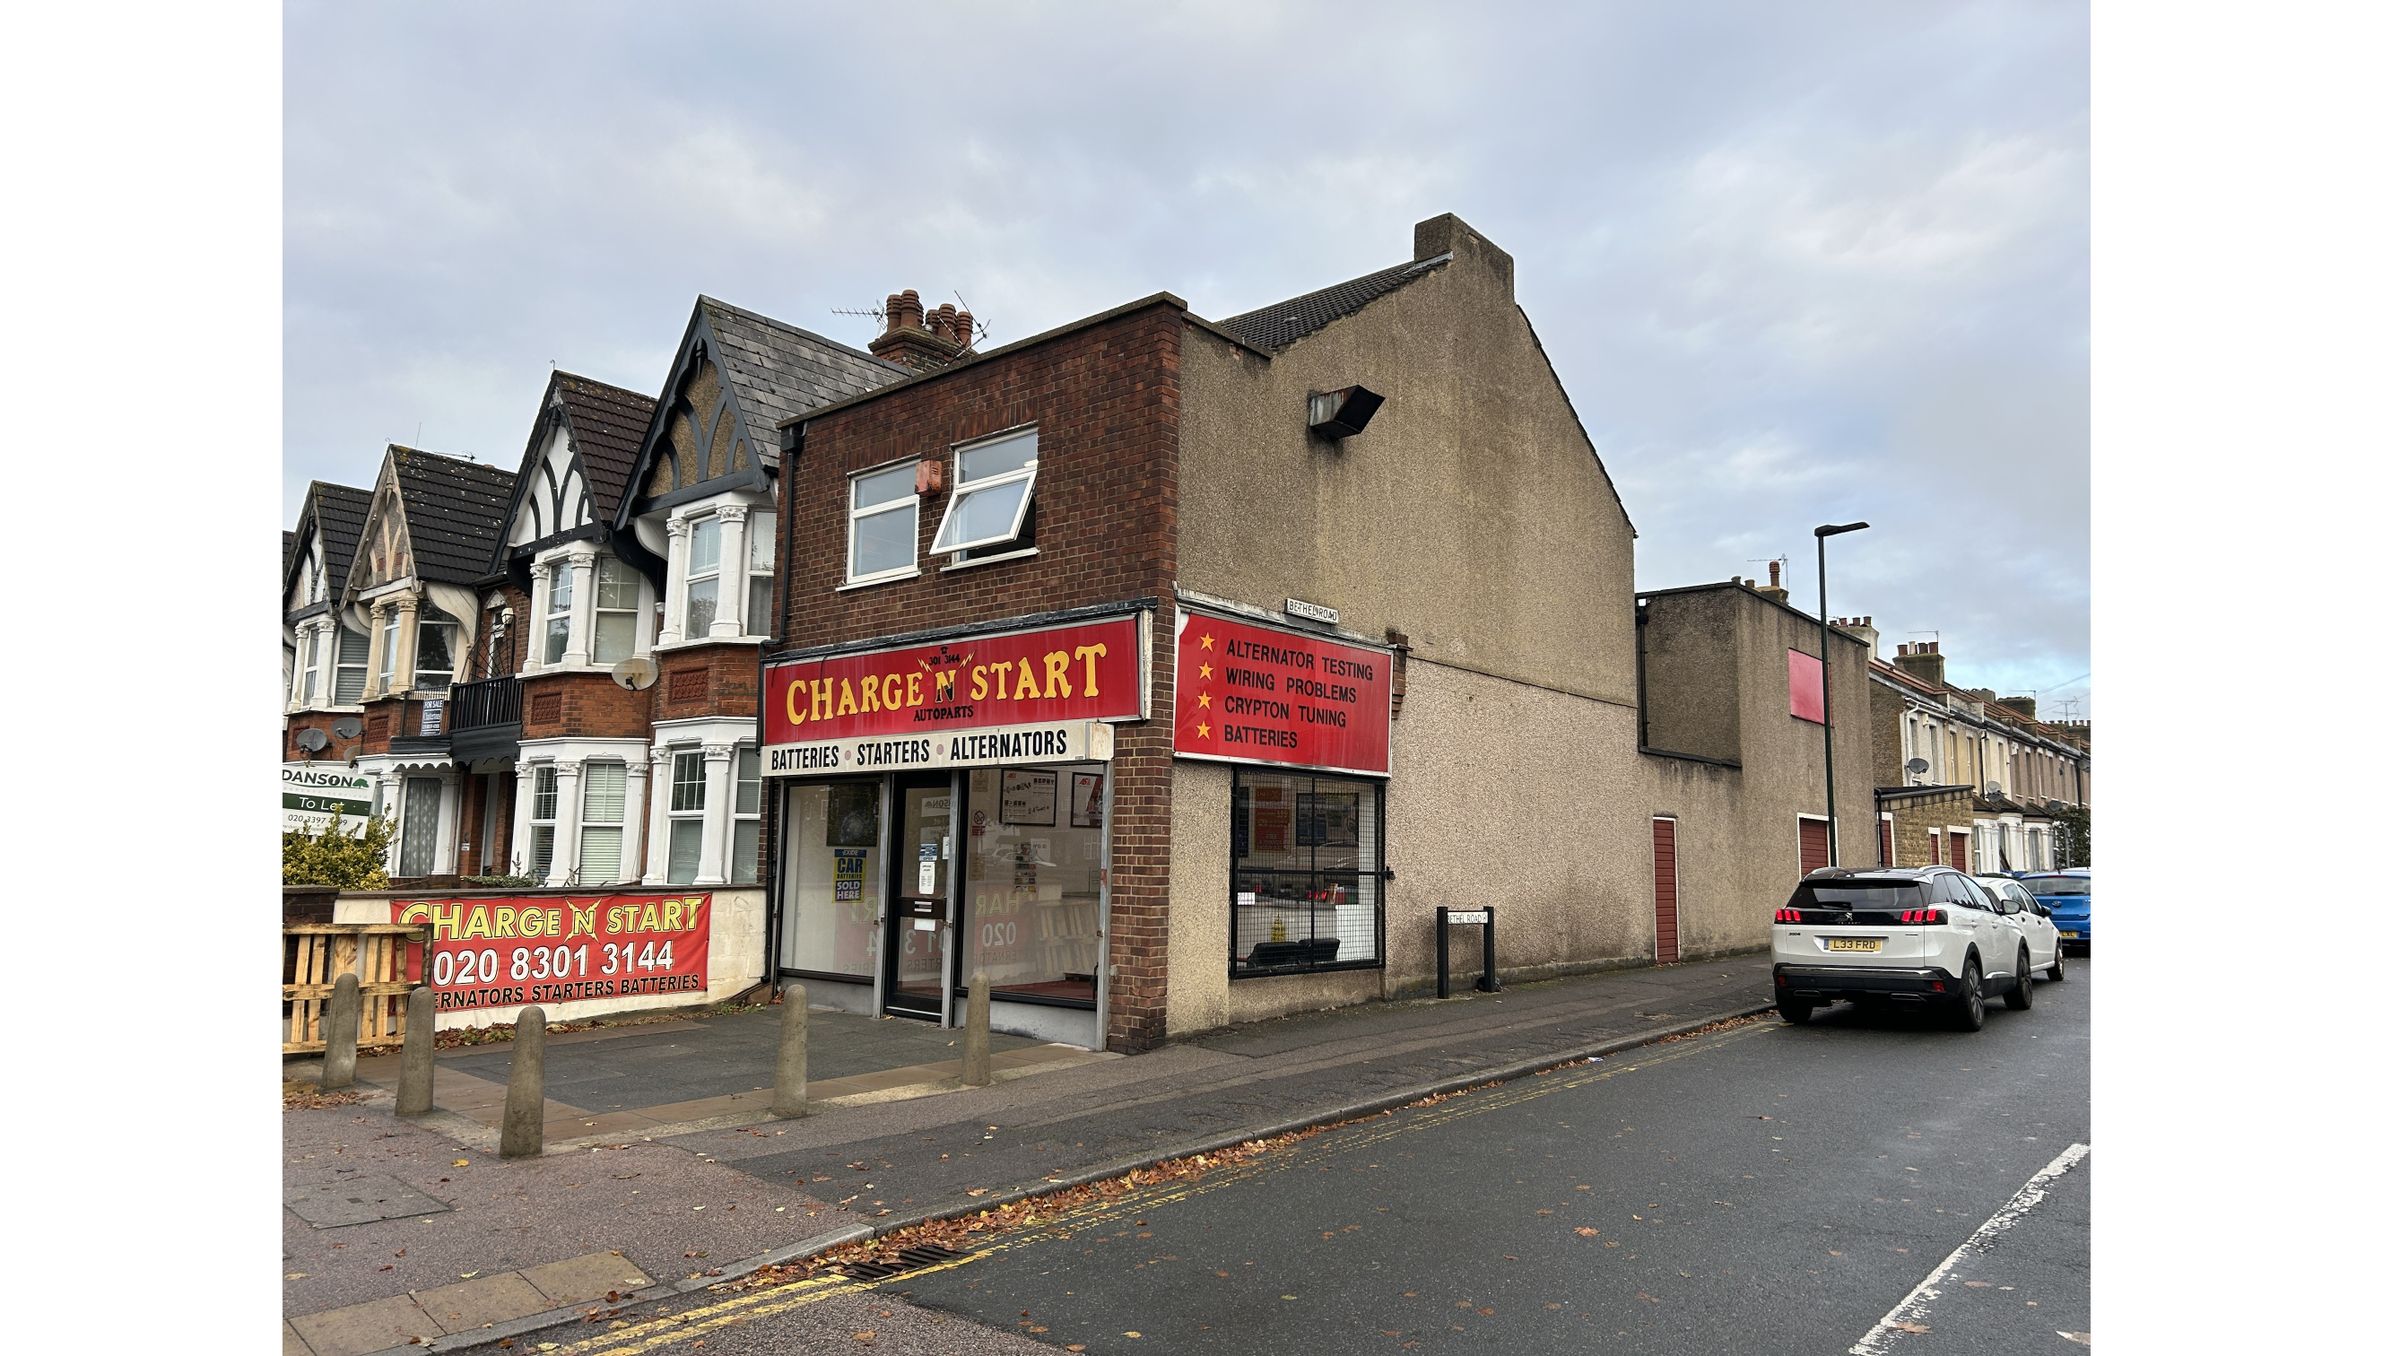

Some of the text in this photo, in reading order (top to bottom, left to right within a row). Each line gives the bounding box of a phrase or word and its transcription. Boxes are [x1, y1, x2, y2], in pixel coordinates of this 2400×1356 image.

[1290, 601, 1338, 621] BETHEL ROAD
[929, 656, 941, 666] 301
[1226, 639, 1374, 681] ALTERNATOR TESTING
[786, 643, 1107, 726] CHARGE N START
[1225, 667, 1357, 703] WIRING PROBLEMS
[433, 700, 442, 708] SALE
[913, 704, 974, 721] AUTOPARTS
[1224, 696, 1346, 728] CRYPTON TUNING
[1224, 724, 1298, 748] BATTERIES
[772, 729, 1067, 770] BATTERIES STARTERS ALTERNATORS
[283, 769, 353, 787] DANSON
[299, 797, 316, 809] To
[288, 814, 304, 822] 020
[838, 858, 863, 873] CAR
[837, 881, 860, 890] SOLD
[837, 890, 860, 900] HERE
[398, 897, 703, 942] CHARGE N START
[1467, 914, 1482, 924] ROAD
[1833, 940, 1876, 949] L33 FRD
[433, 940, 674, 986] 020 8301 3144
[532, 980, 614, 1001] STARTERS
[621, 975, 699, 993] BATTERIES
